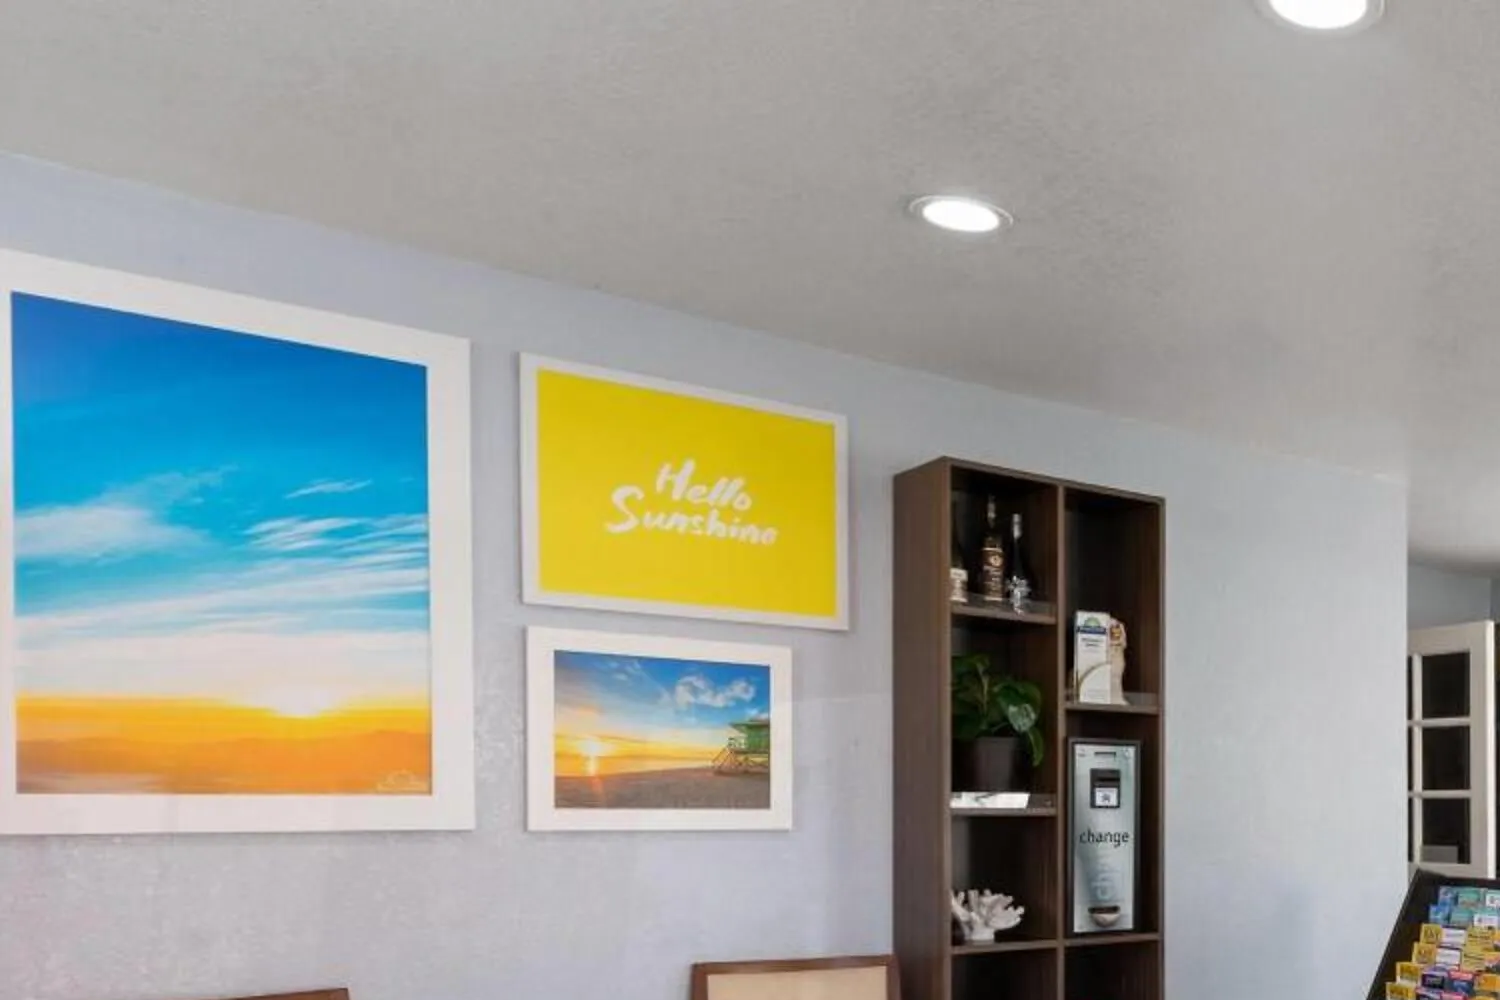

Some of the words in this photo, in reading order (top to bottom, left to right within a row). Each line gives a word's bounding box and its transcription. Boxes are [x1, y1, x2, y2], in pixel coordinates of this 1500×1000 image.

[655, 458, 752, 511] Hello
[605, 484, 778, 545] Sunshine
[1079, 826, 1130, 849] change
